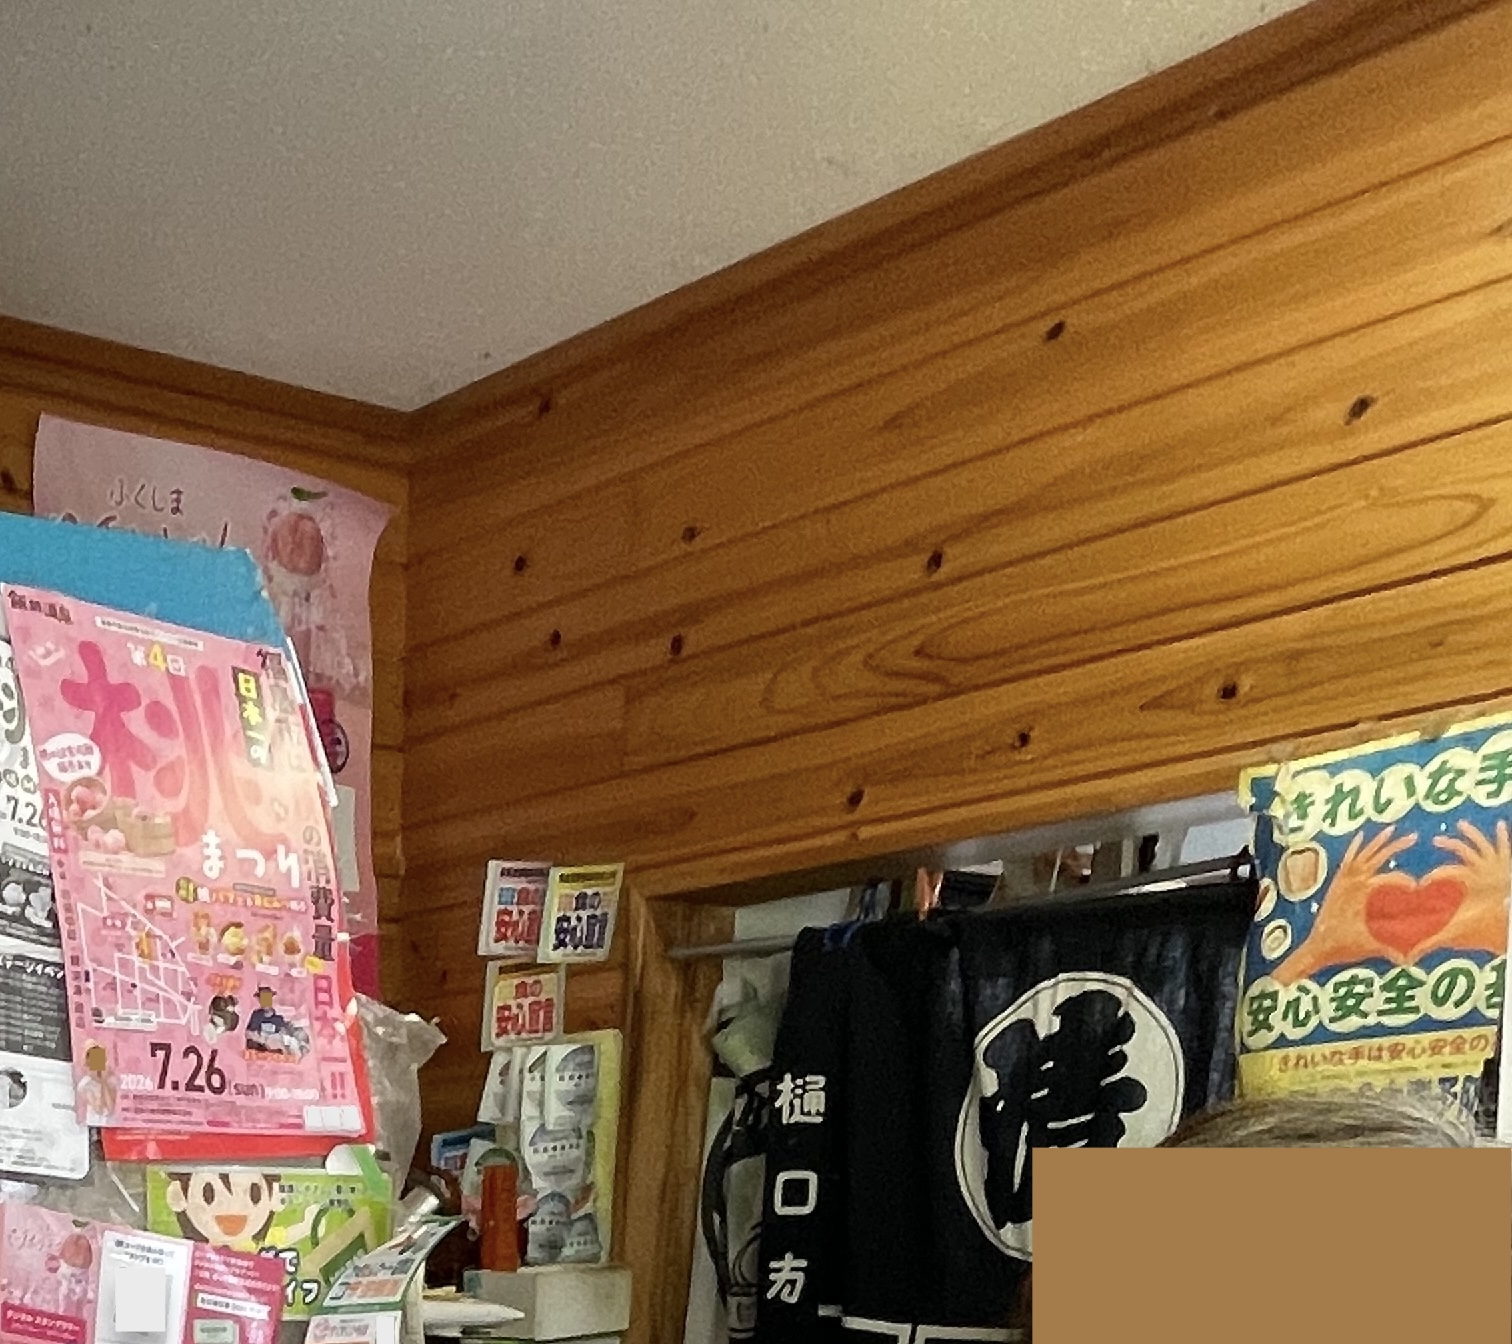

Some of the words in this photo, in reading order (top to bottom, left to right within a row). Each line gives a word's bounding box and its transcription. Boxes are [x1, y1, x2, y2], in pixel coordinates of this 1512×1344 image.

[201, 829, 299, 888] まつり
[150, 1042, 226, 1095] 7.26
[1278, 1032, 1497, 1073] きれいな手は安心安全の
